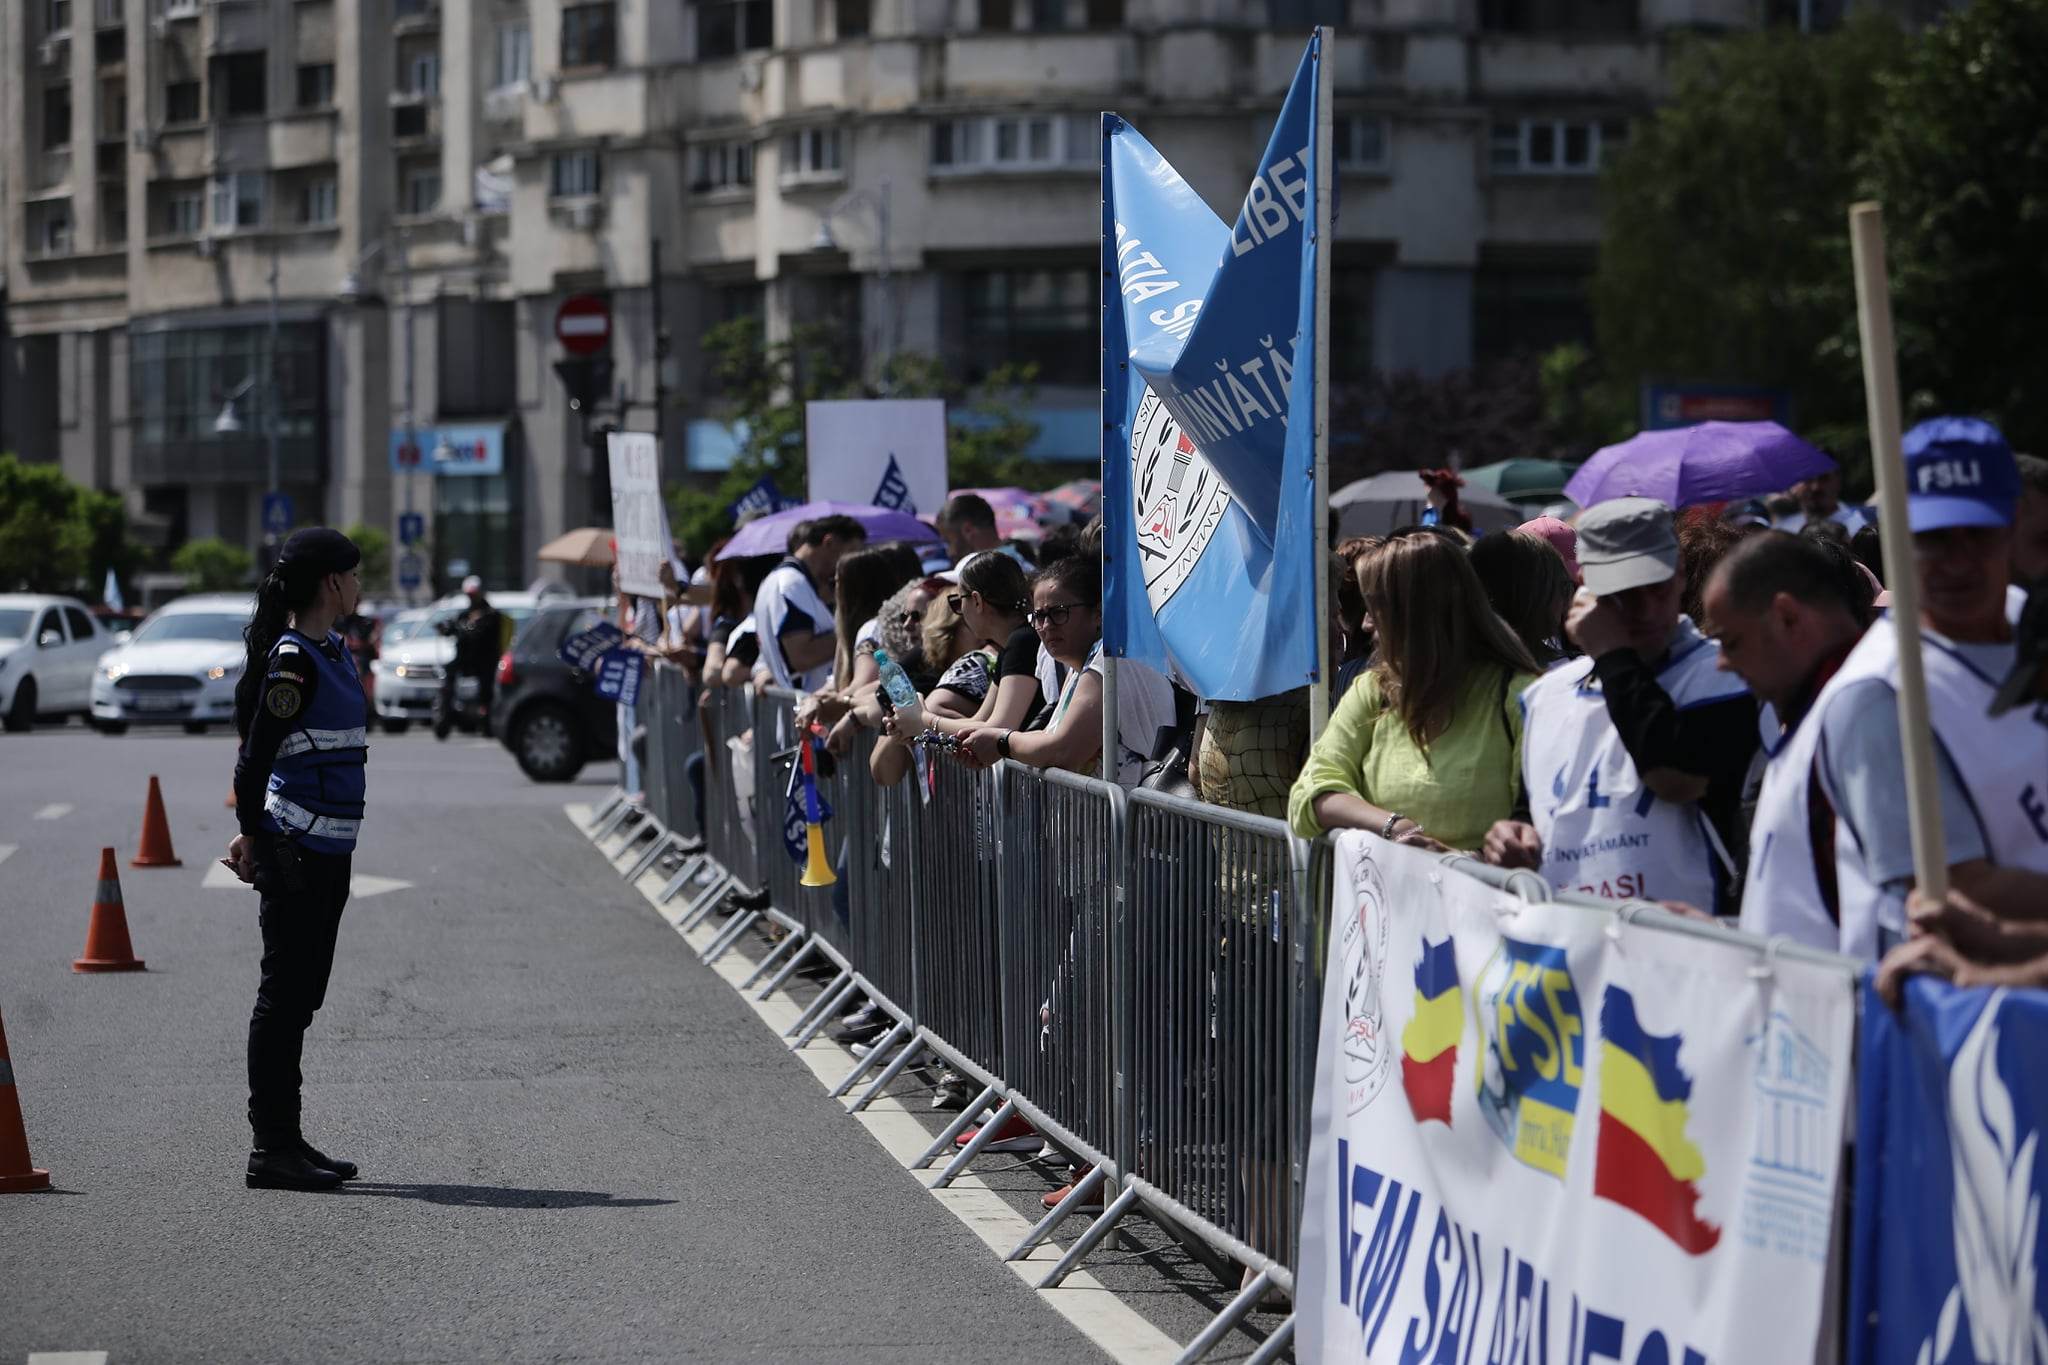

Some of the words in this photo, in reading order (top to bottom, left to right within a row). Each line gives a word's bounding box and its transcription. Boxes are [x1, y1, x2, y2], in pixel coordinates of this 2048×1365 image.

[1231, 146, 1308, 258] LIBE
[1916, 459, 1982, 494] FSLI
[1497, 960, 1584, 1088] FSE
